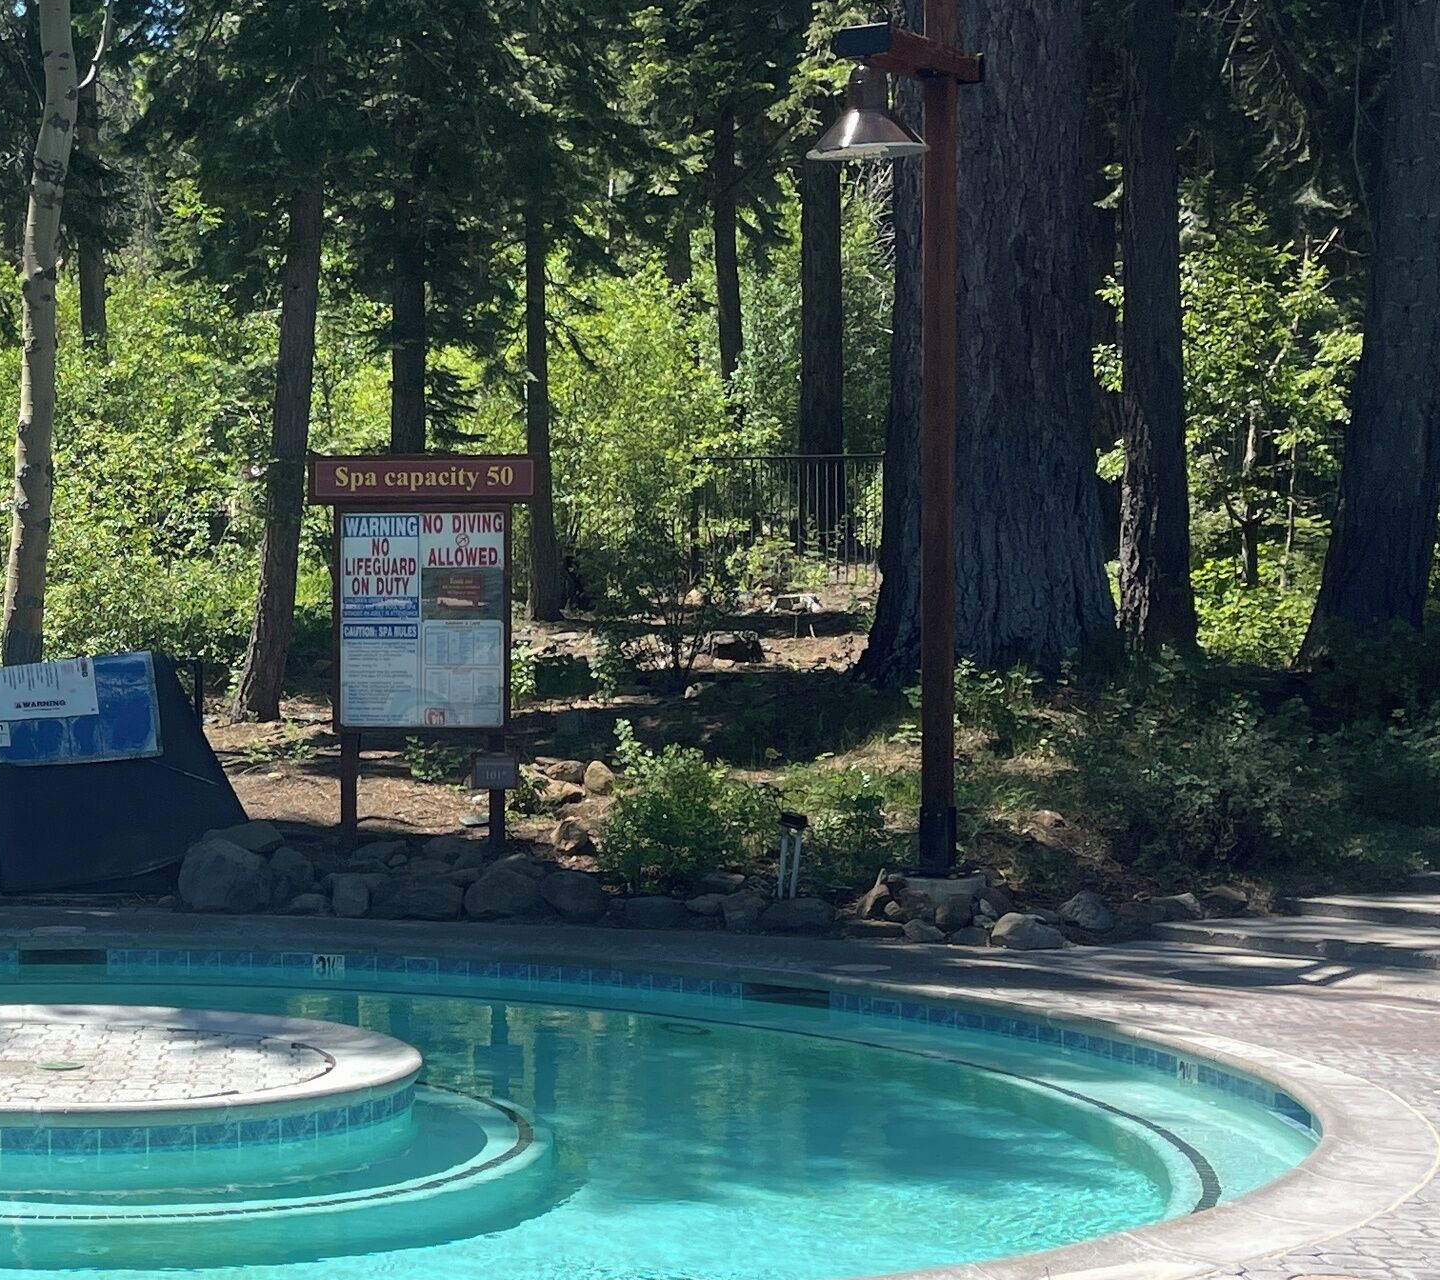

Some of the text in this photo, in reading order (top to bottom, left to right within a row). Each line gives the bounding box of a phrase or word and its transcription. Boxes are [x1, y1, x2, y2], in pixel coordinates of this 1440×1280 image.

[335, 466, 513, 491] Spa capacity 50
[345, 517, 418, 536] WARNING
[423, 514, 503, 533] NO DIVING
[372, 538, 389, 556] NO
[428, 547, 498, 566] ALLOWED
[345, 558, 416, 576] LIFEGUARD
[352, 577, 409, 595] ON DUTY
[379, 626, 393, 637] SPA
[394, 626, 417, 637] RULES
